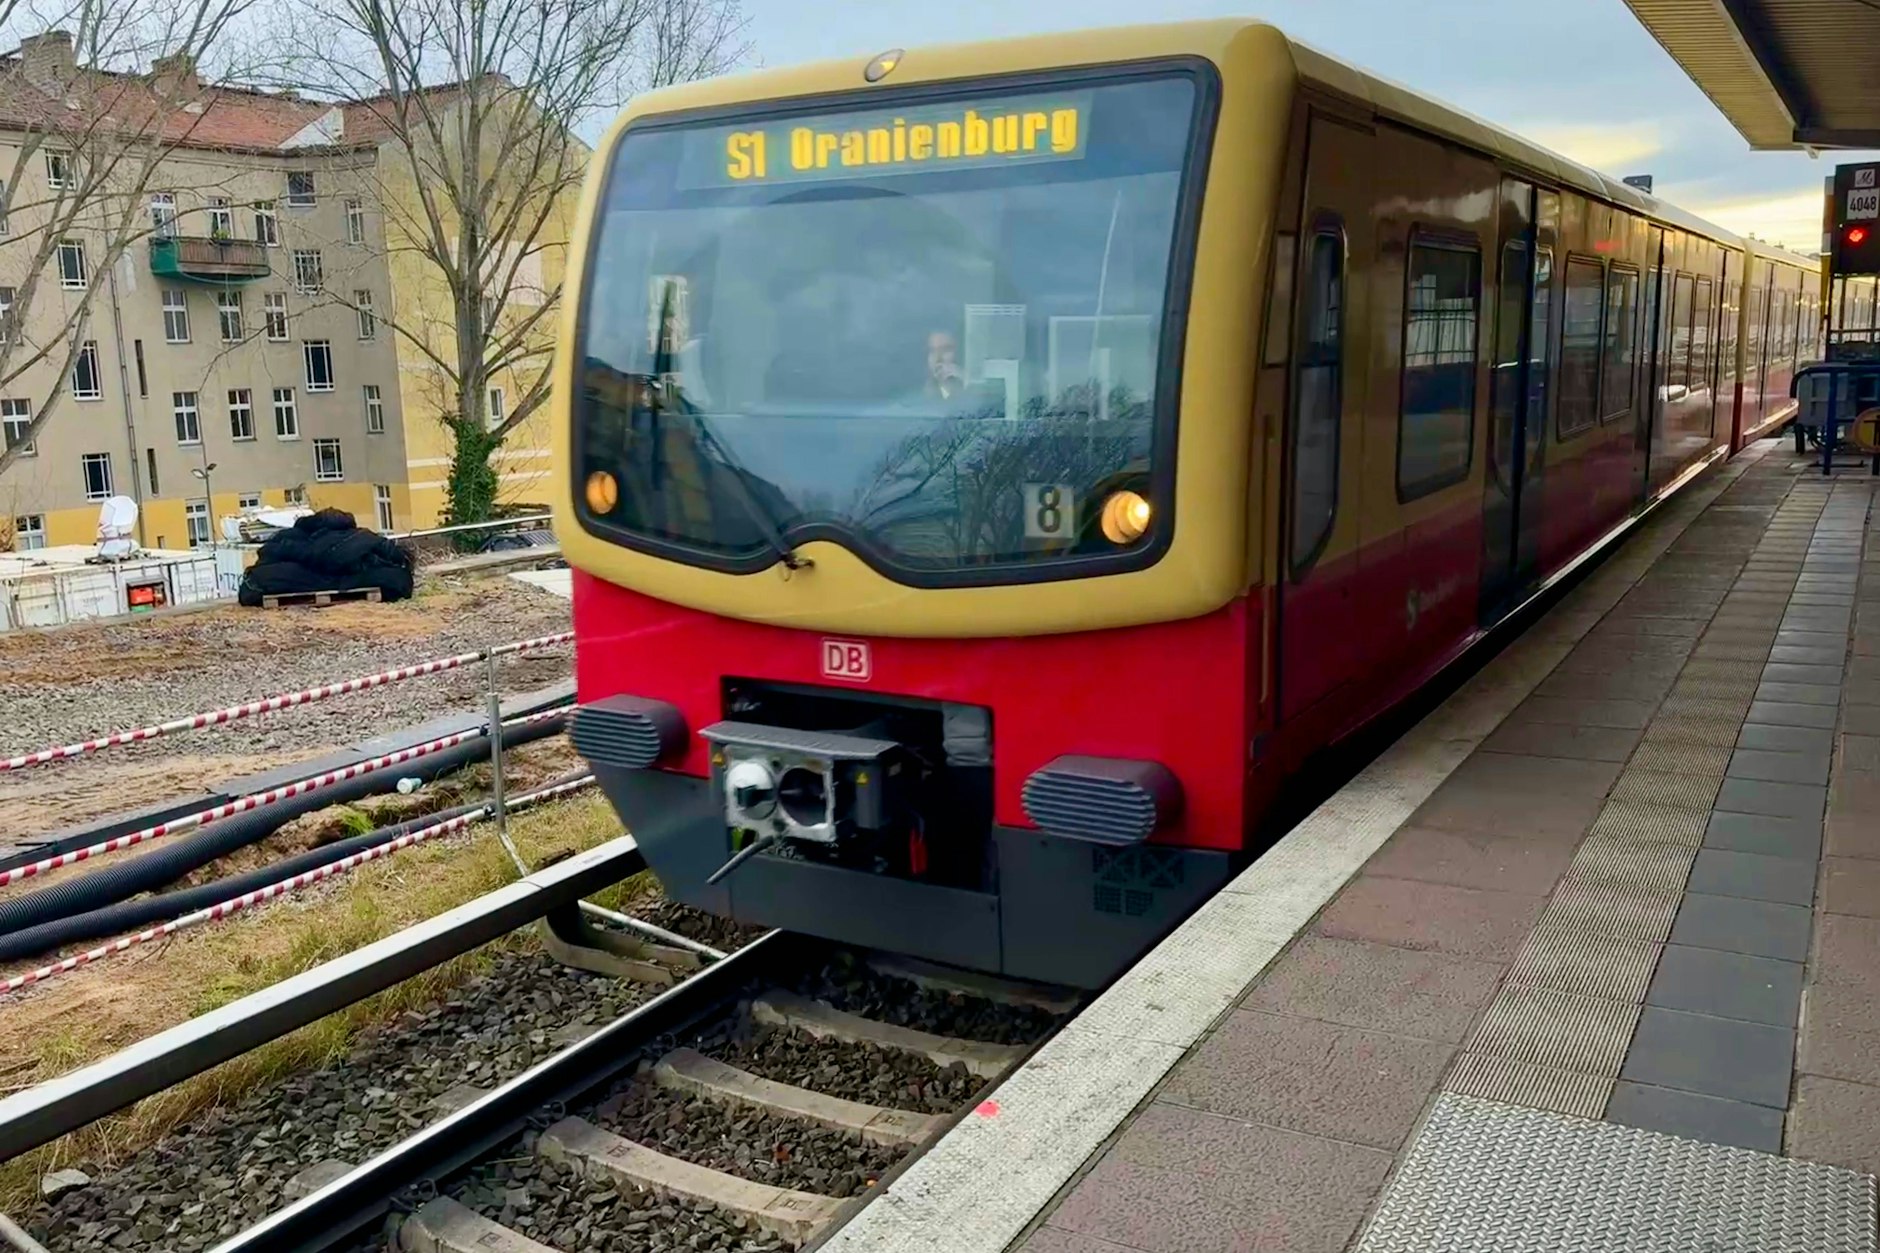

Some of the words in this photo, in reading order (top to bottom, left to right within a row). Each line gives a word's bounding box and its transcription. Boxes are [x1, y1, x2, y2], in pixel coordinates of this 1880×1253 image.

[727, 131, 766, 179] S1
[790, 108, 1078, 170] Oranienburg
[1849, 196, 1877, 212] 4048
[1037, 485, 1061, 534] 8
[828, 644, 863, 674] DB
